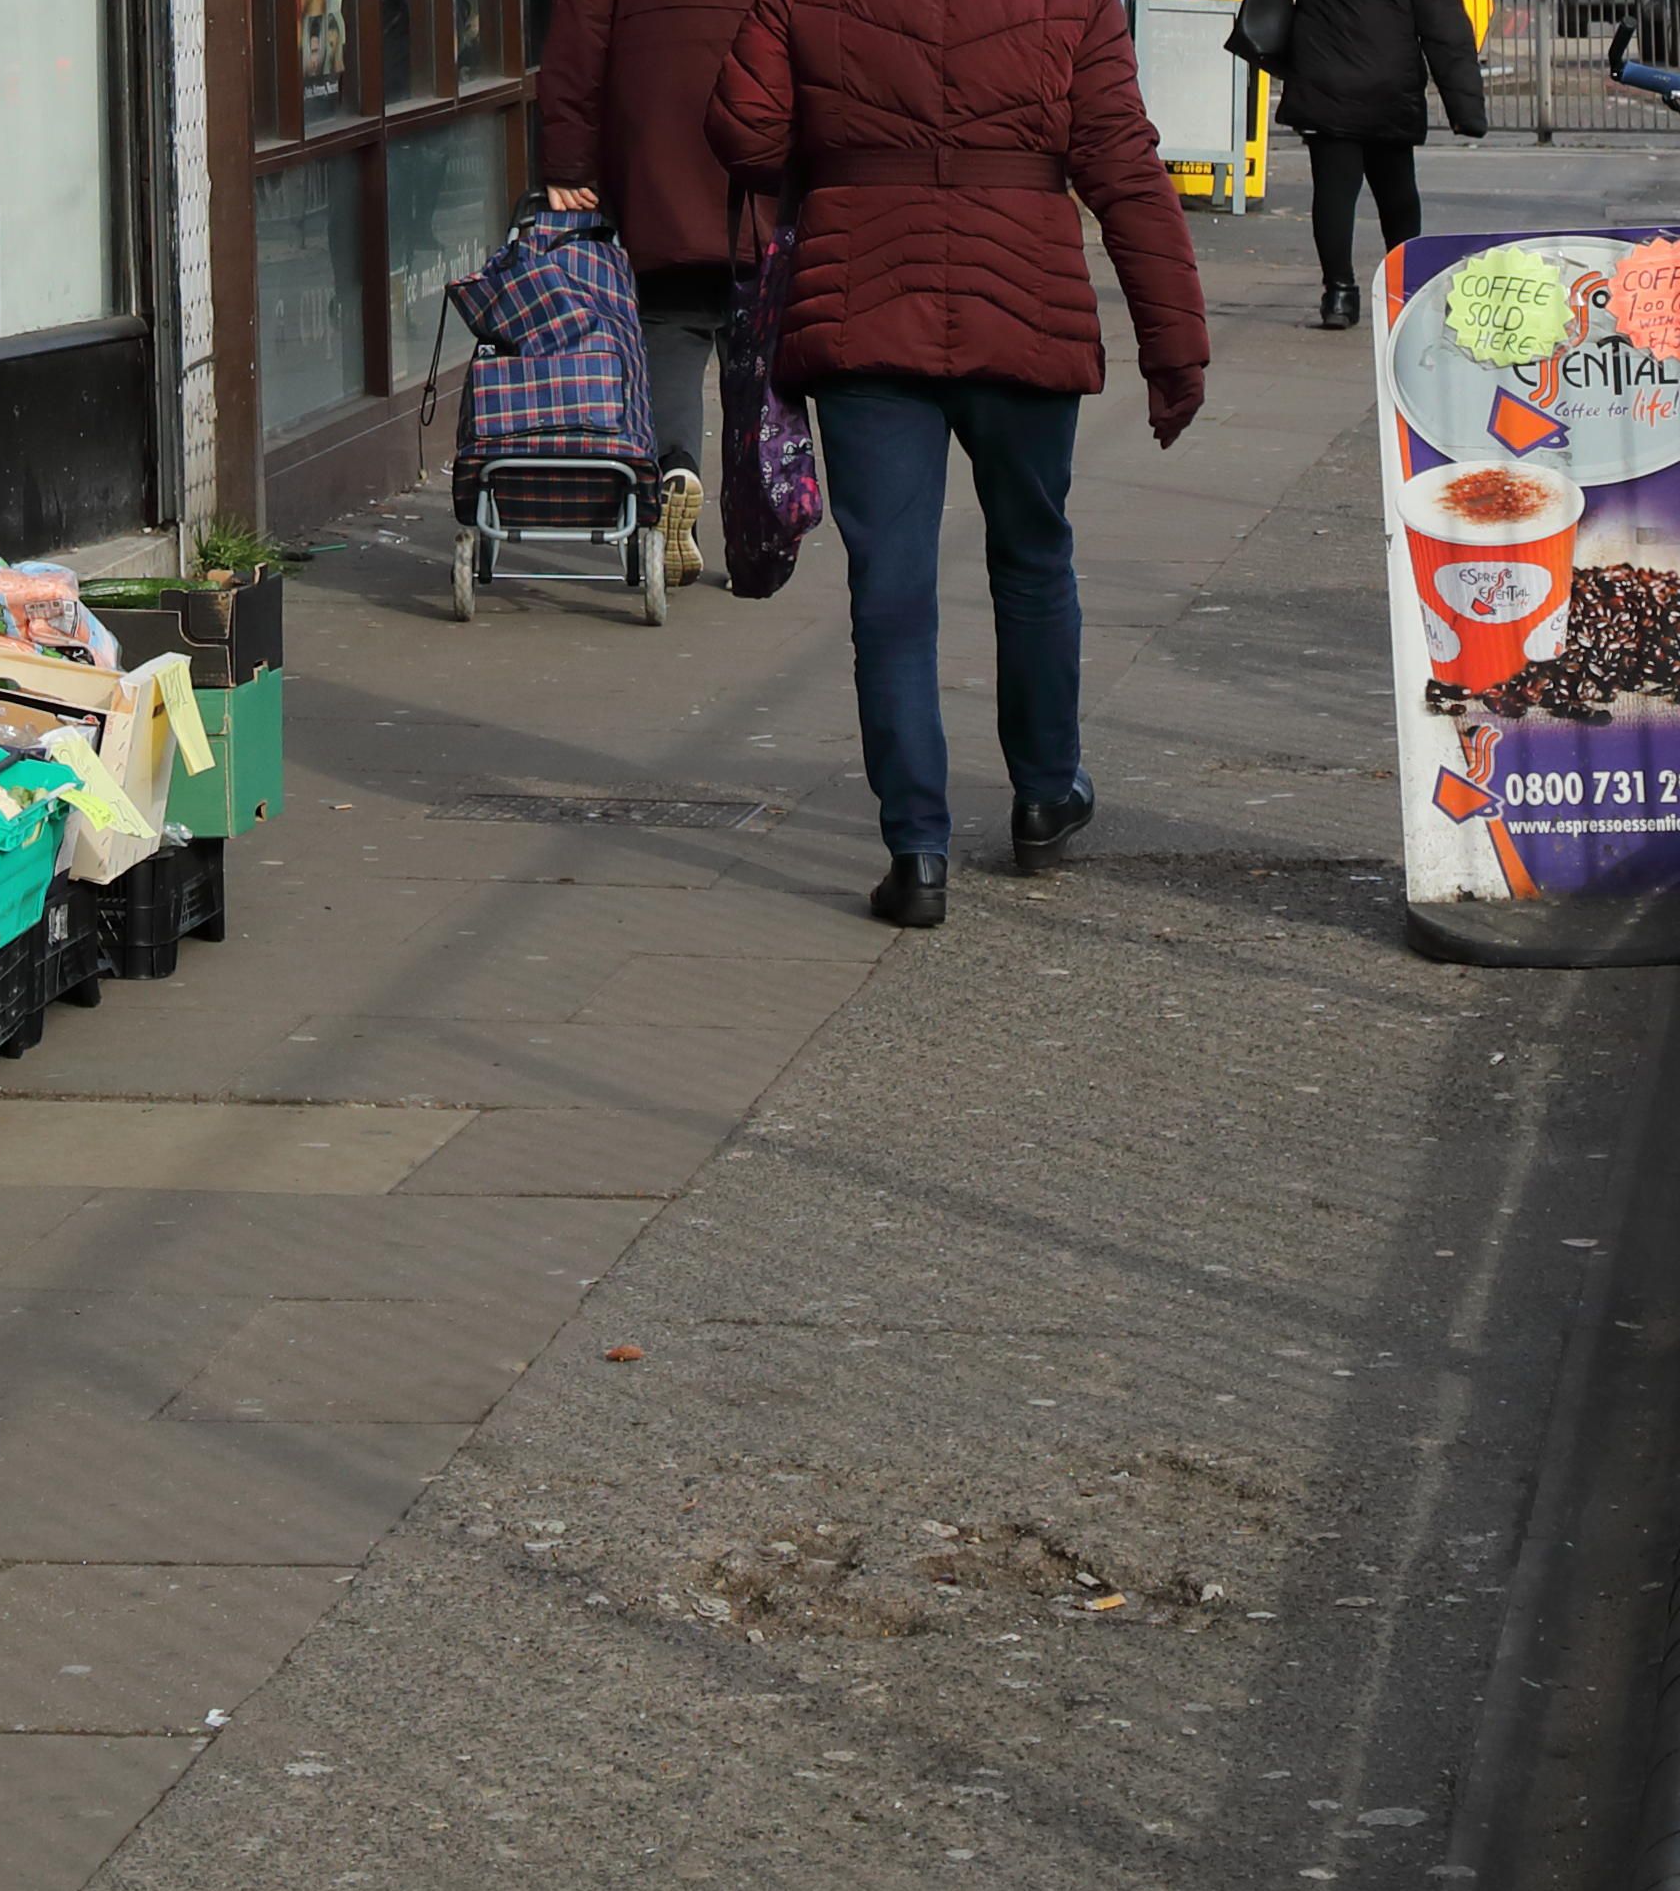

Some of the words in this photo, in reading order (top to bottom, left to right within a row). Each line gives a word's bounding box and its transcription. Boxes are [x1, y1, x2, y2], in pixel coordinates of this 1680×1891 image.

[1461, 275, 1556, 305] COFFEE
[1465, 302, 1524, 331] SOLD
[1640, 317, 1676, 329] WITH
[1474, 332, 1536, 356] HERE
[1554, 401, 1600, 418] Coffee
[1608, 403, 1629, 415] for
[1633, 388, 1679, 427] life!
[1506, 773, 1582, 806] 0800
[1592, 770, 1645, 803] 731
